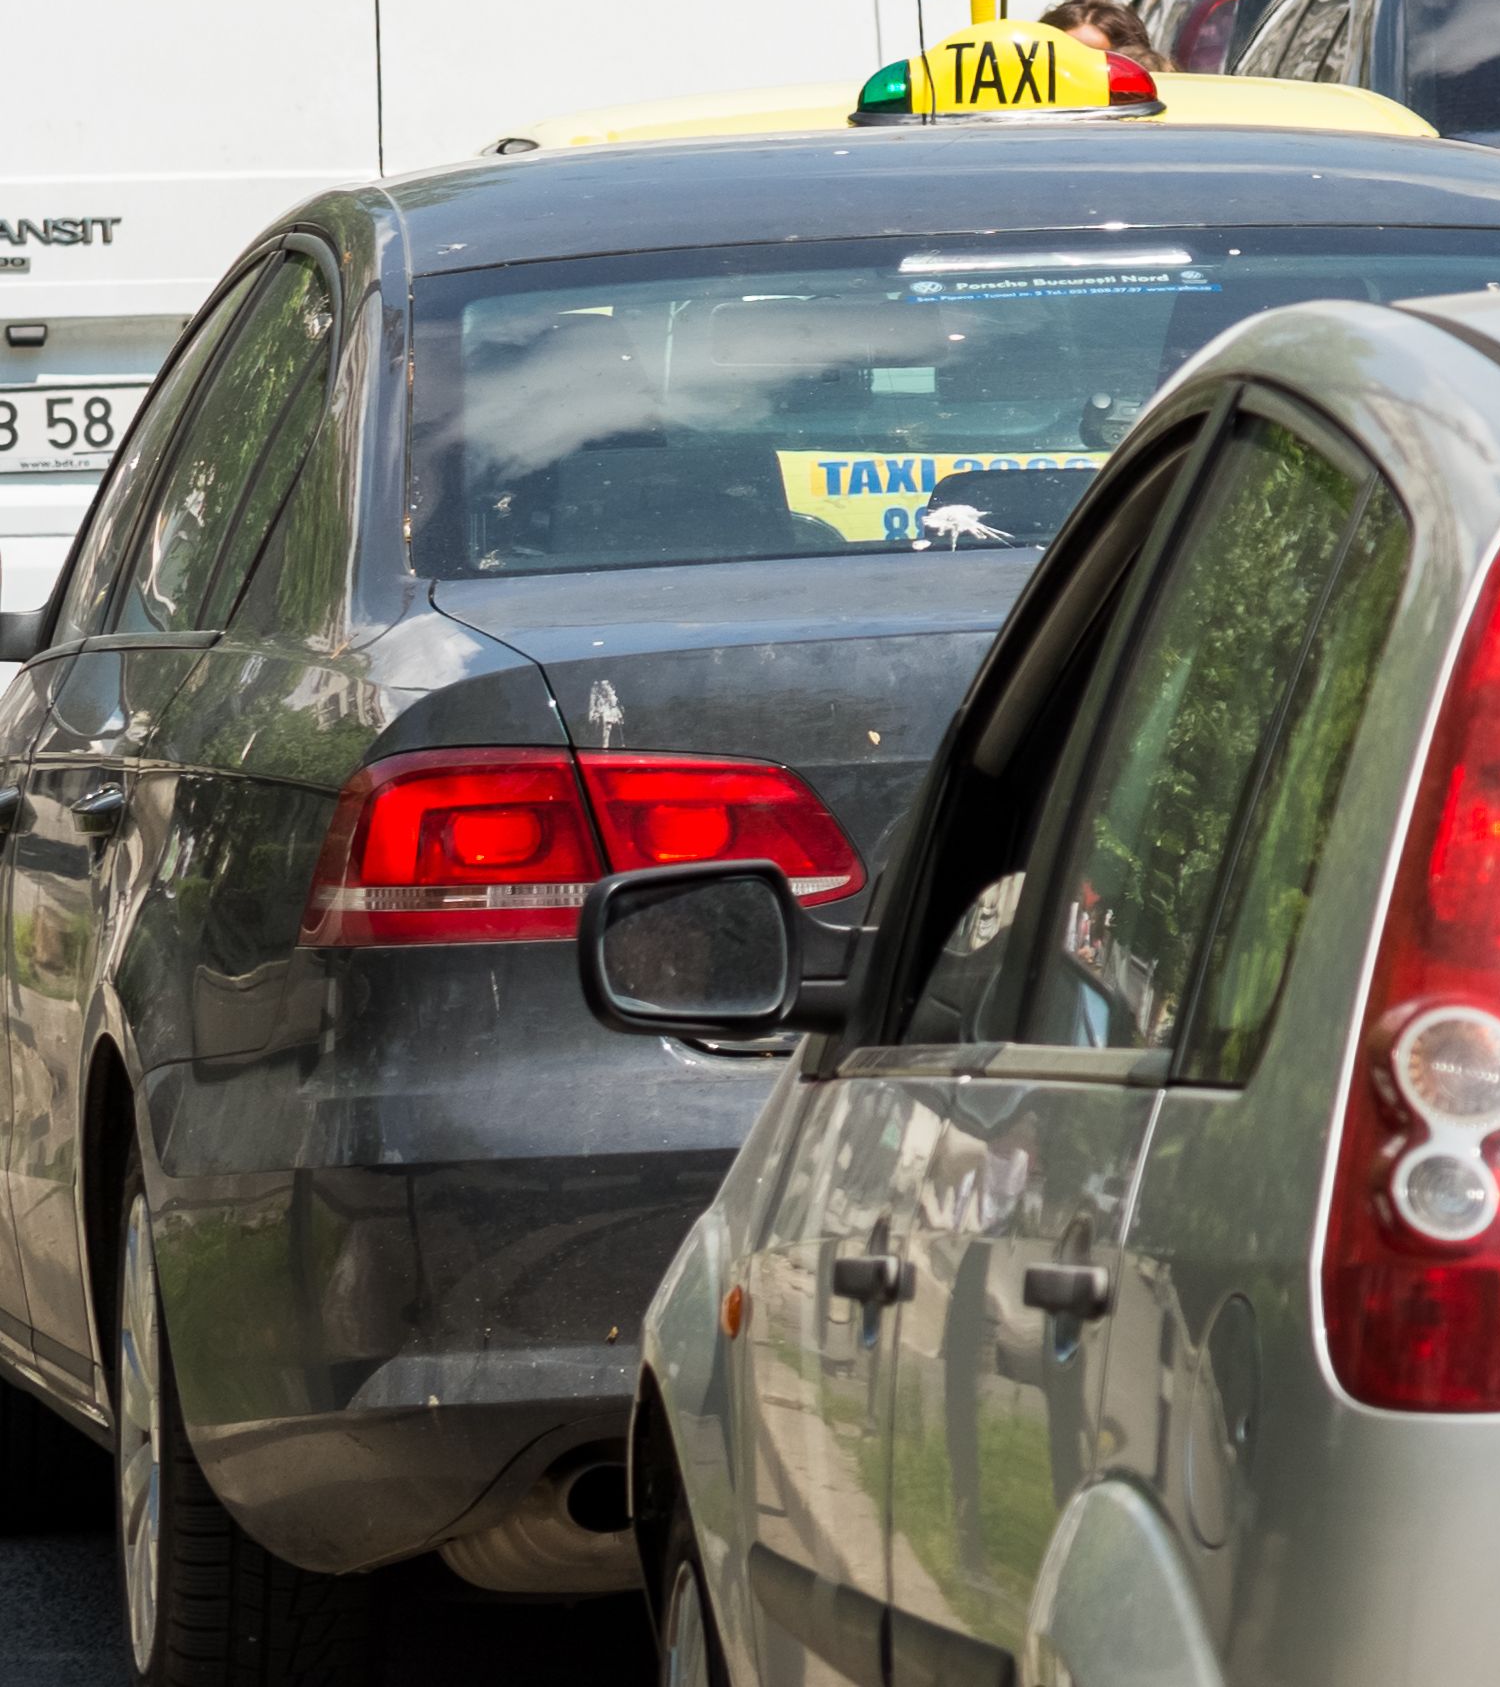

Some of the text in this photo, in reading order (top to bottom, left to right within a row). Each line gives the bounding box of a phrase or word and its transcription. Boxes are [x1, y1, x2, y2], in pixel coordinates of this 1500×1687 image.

[946, 40, 1058, 105] TAXI
[956, 278, 1028, 291] Porsche
[1121, 273, 1170, 284] Nord
[45, 396, 115, 450] 58
[818, 458, 937, 496] TAXI
